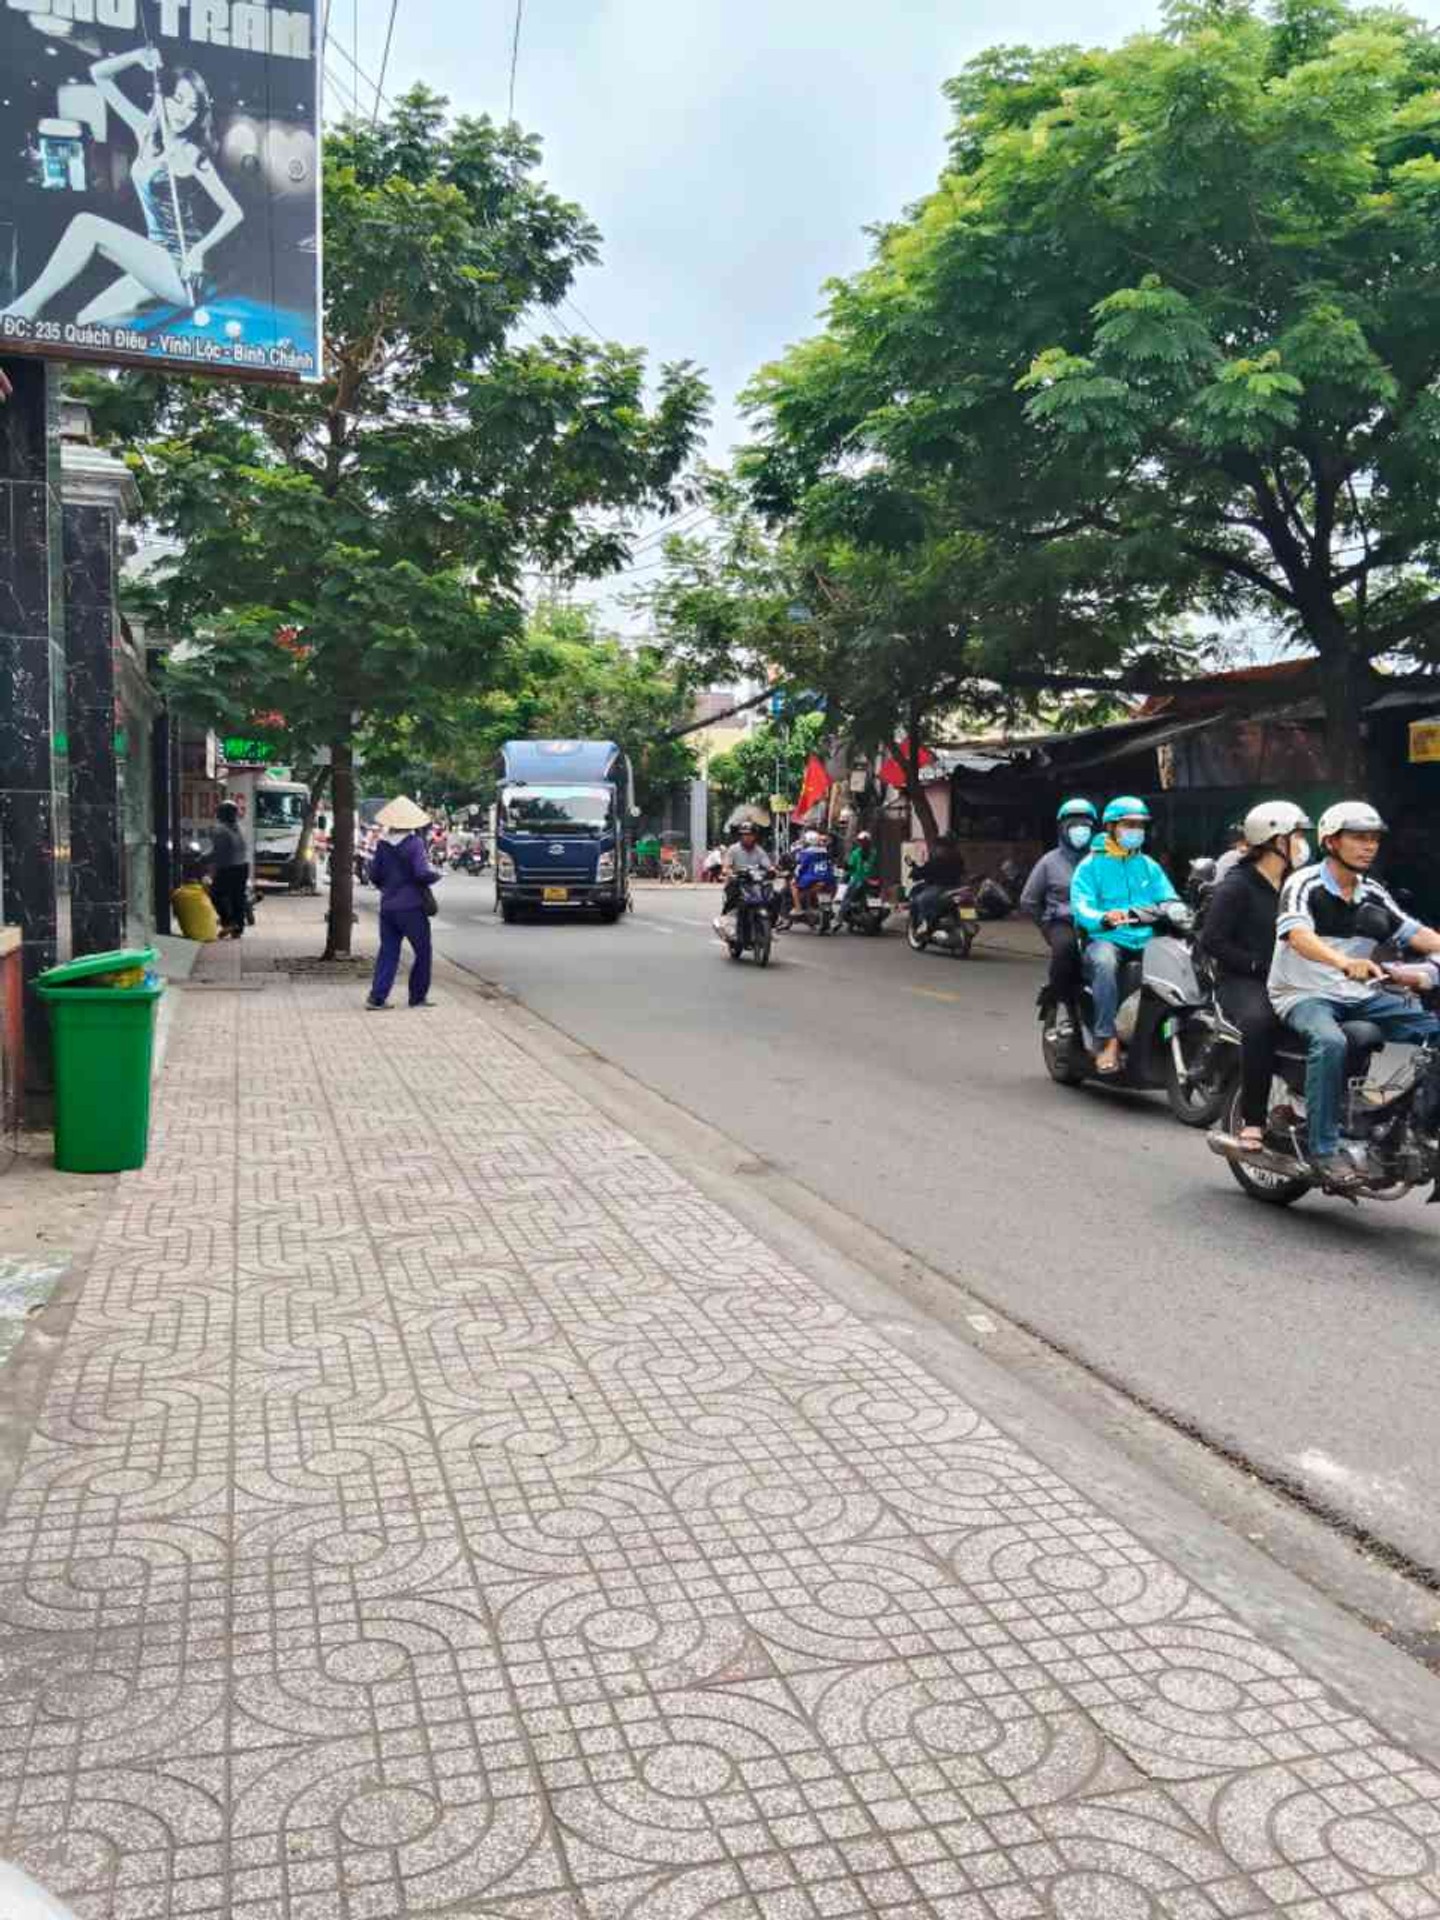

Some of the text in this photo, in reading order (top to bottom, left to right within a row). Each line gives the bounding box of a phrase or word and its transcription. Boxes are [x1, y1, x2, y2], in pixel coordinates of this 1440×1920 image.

[4, 316, 32, 337] ĐC:
[35, 321, 61, 340] 235
[64, 323, 111, 345] Quách
